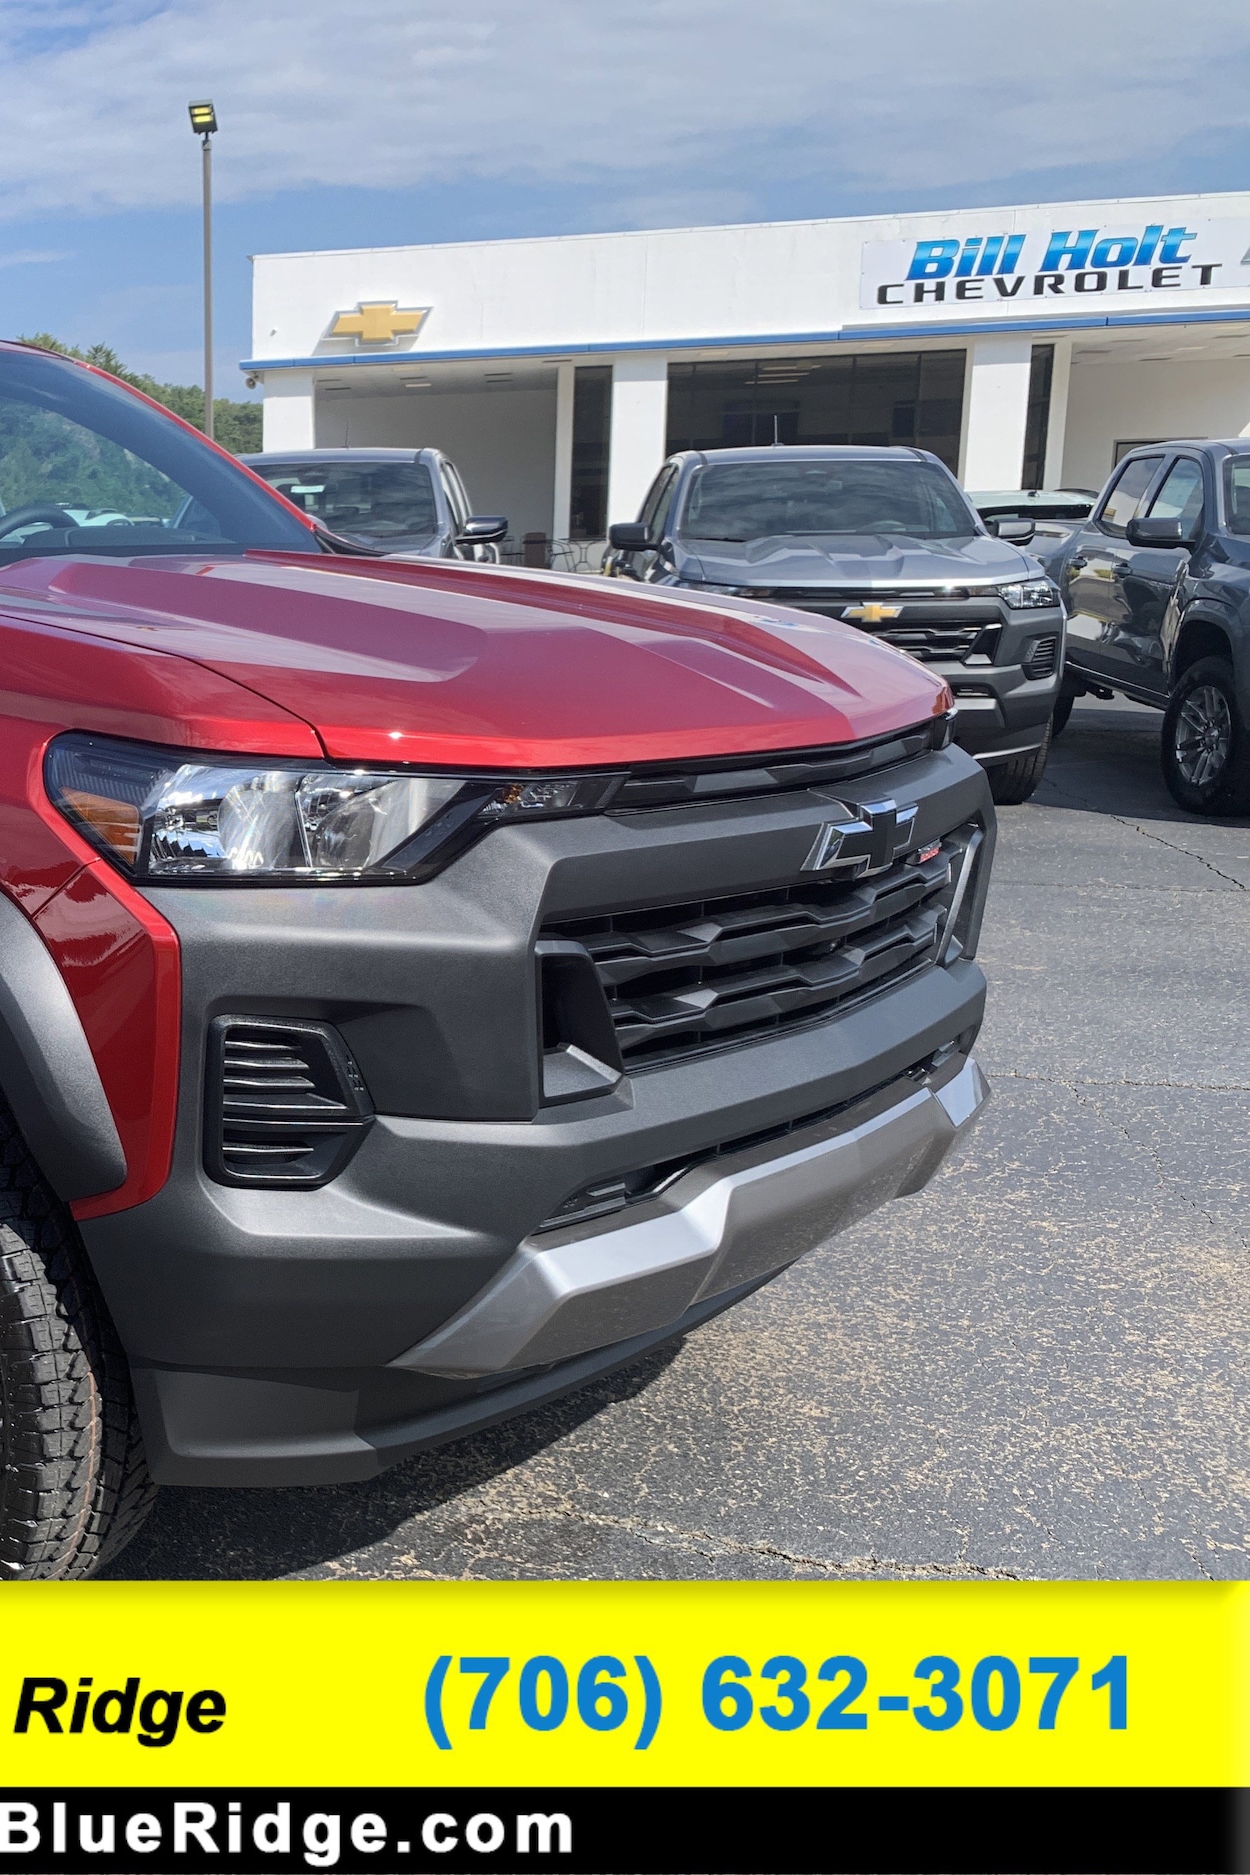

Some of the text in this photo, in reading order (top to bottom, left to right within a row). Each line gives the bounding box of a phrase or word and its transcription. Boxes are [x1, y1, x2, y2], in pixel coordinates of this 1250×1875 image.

[904, 224, 1197, 281] Bill Holt
[876, 263, 1223, 306] CHEVROLET
